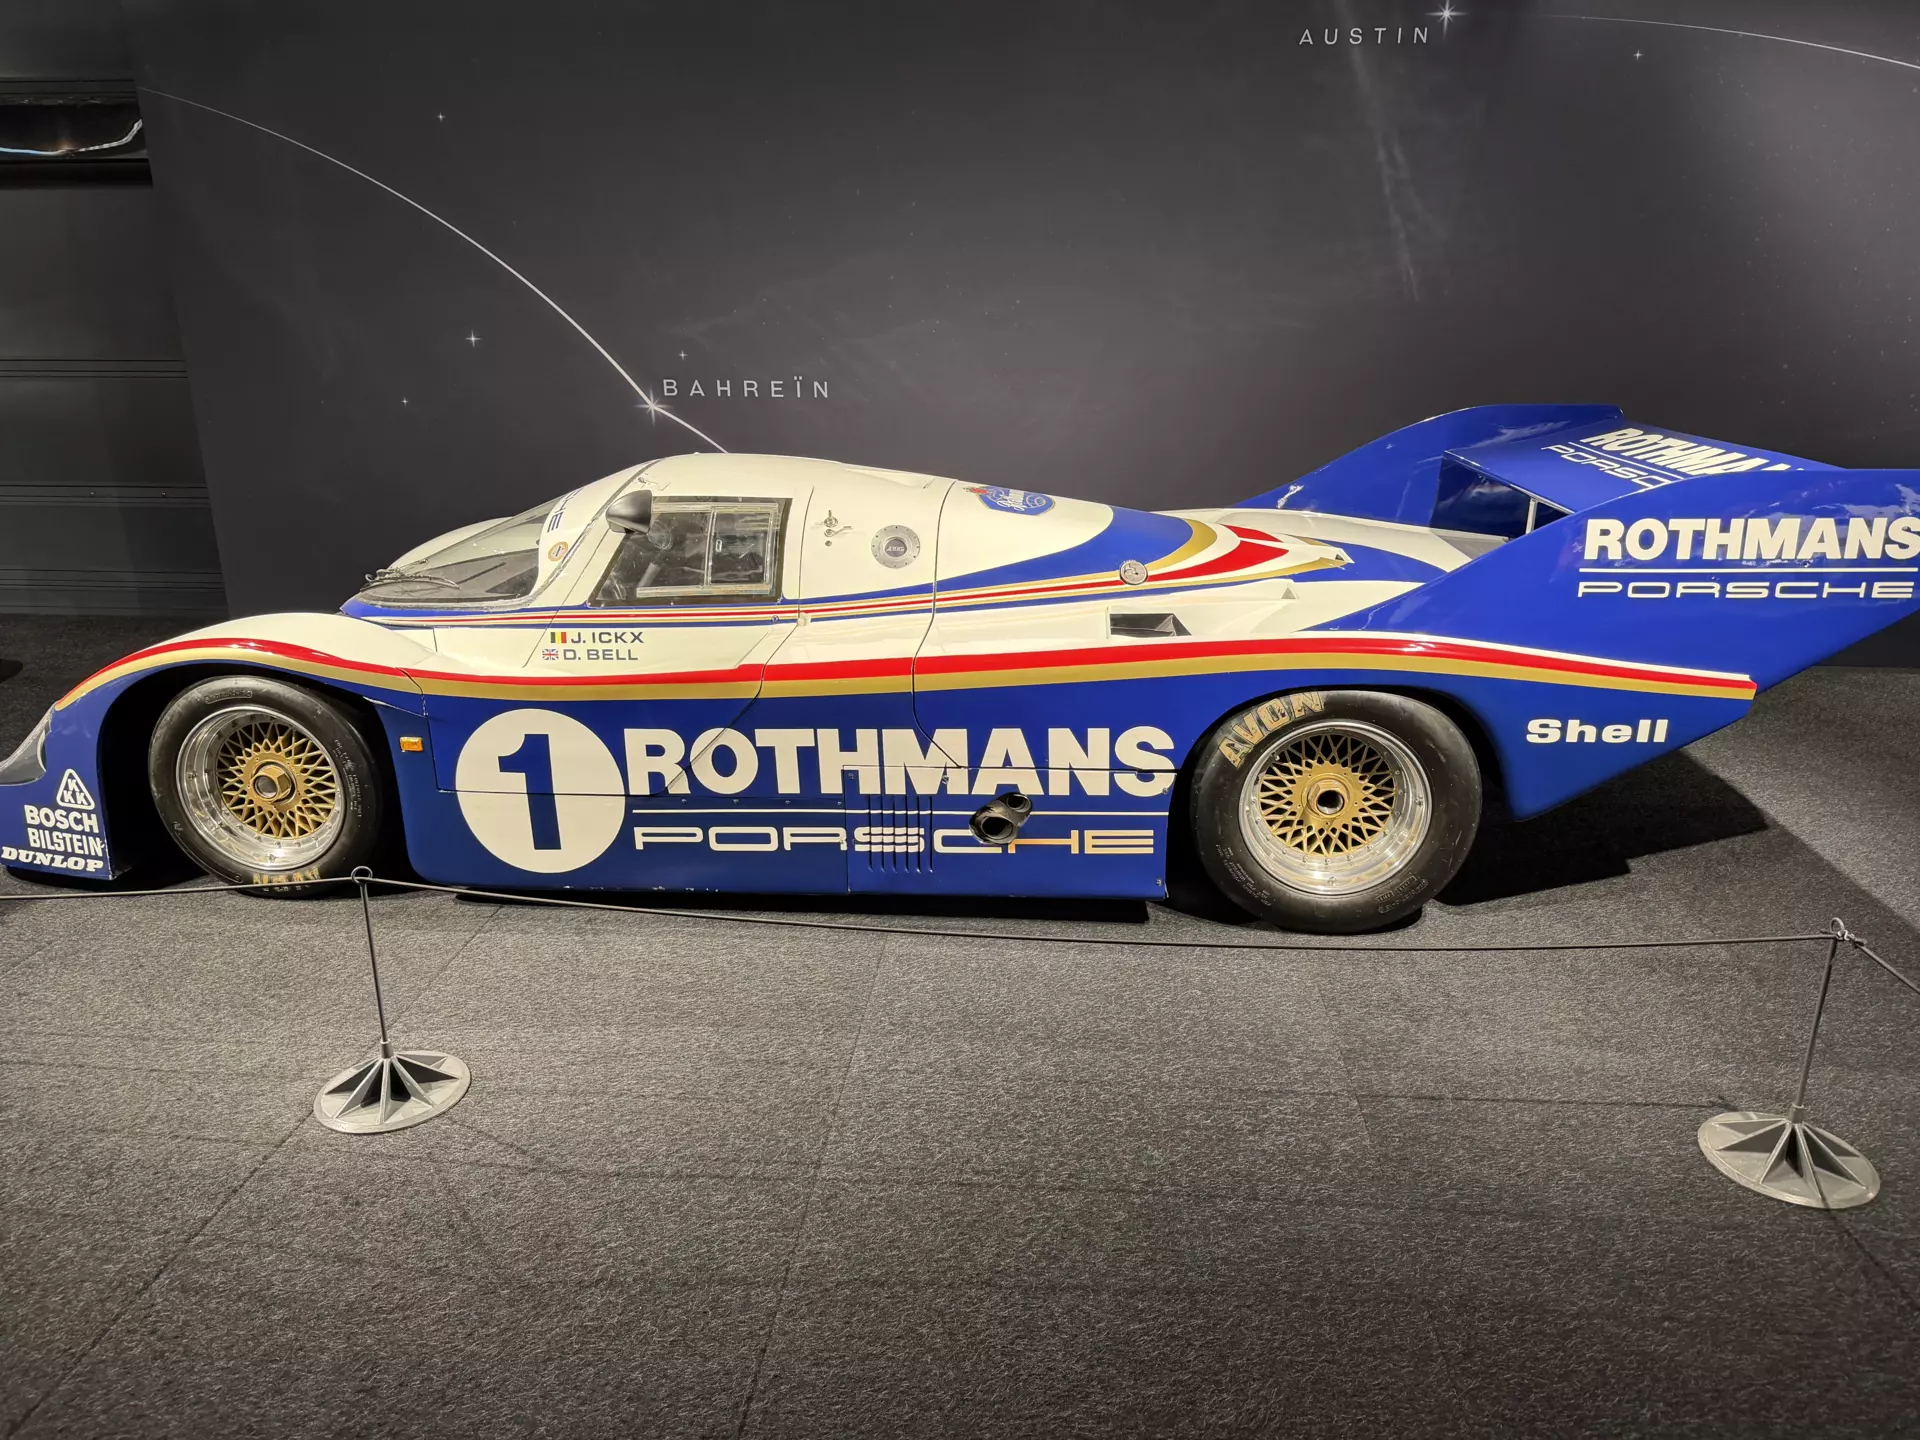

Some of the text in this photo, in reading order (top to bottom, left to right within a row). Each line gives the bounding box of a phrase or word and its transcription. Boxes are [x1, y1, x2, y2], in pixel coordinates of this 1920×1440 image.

[1299, 27, 1428, 45] AUSTIN
[662, 375, 828, 398] BAHREÏN
[1580, 427, 1805, 476] ROTHMA
[1541, 444, 1673, 492] PORSC
[1583, 517, 1920, 561] ROTHMANS
[1577, 581, 1915, 599] PORSCHE
[570, 631, 644, 643] J. ICKX
[563, 648, 638, 660] D. BELL
[1218, 691, 1324, 769] AVON
[1526, 718, 1669, 744] Shell
[623, 726, 1178, 797] ROTHMANS
[498, 733, 562, 850] 1
[24, 804, 99, 833] BOSCH
[27, 827, 103, 857] BILSTEIN
[633, 826, 1154, 854] PORSCHE
[1, 846, 104, 872] DUNLOP
